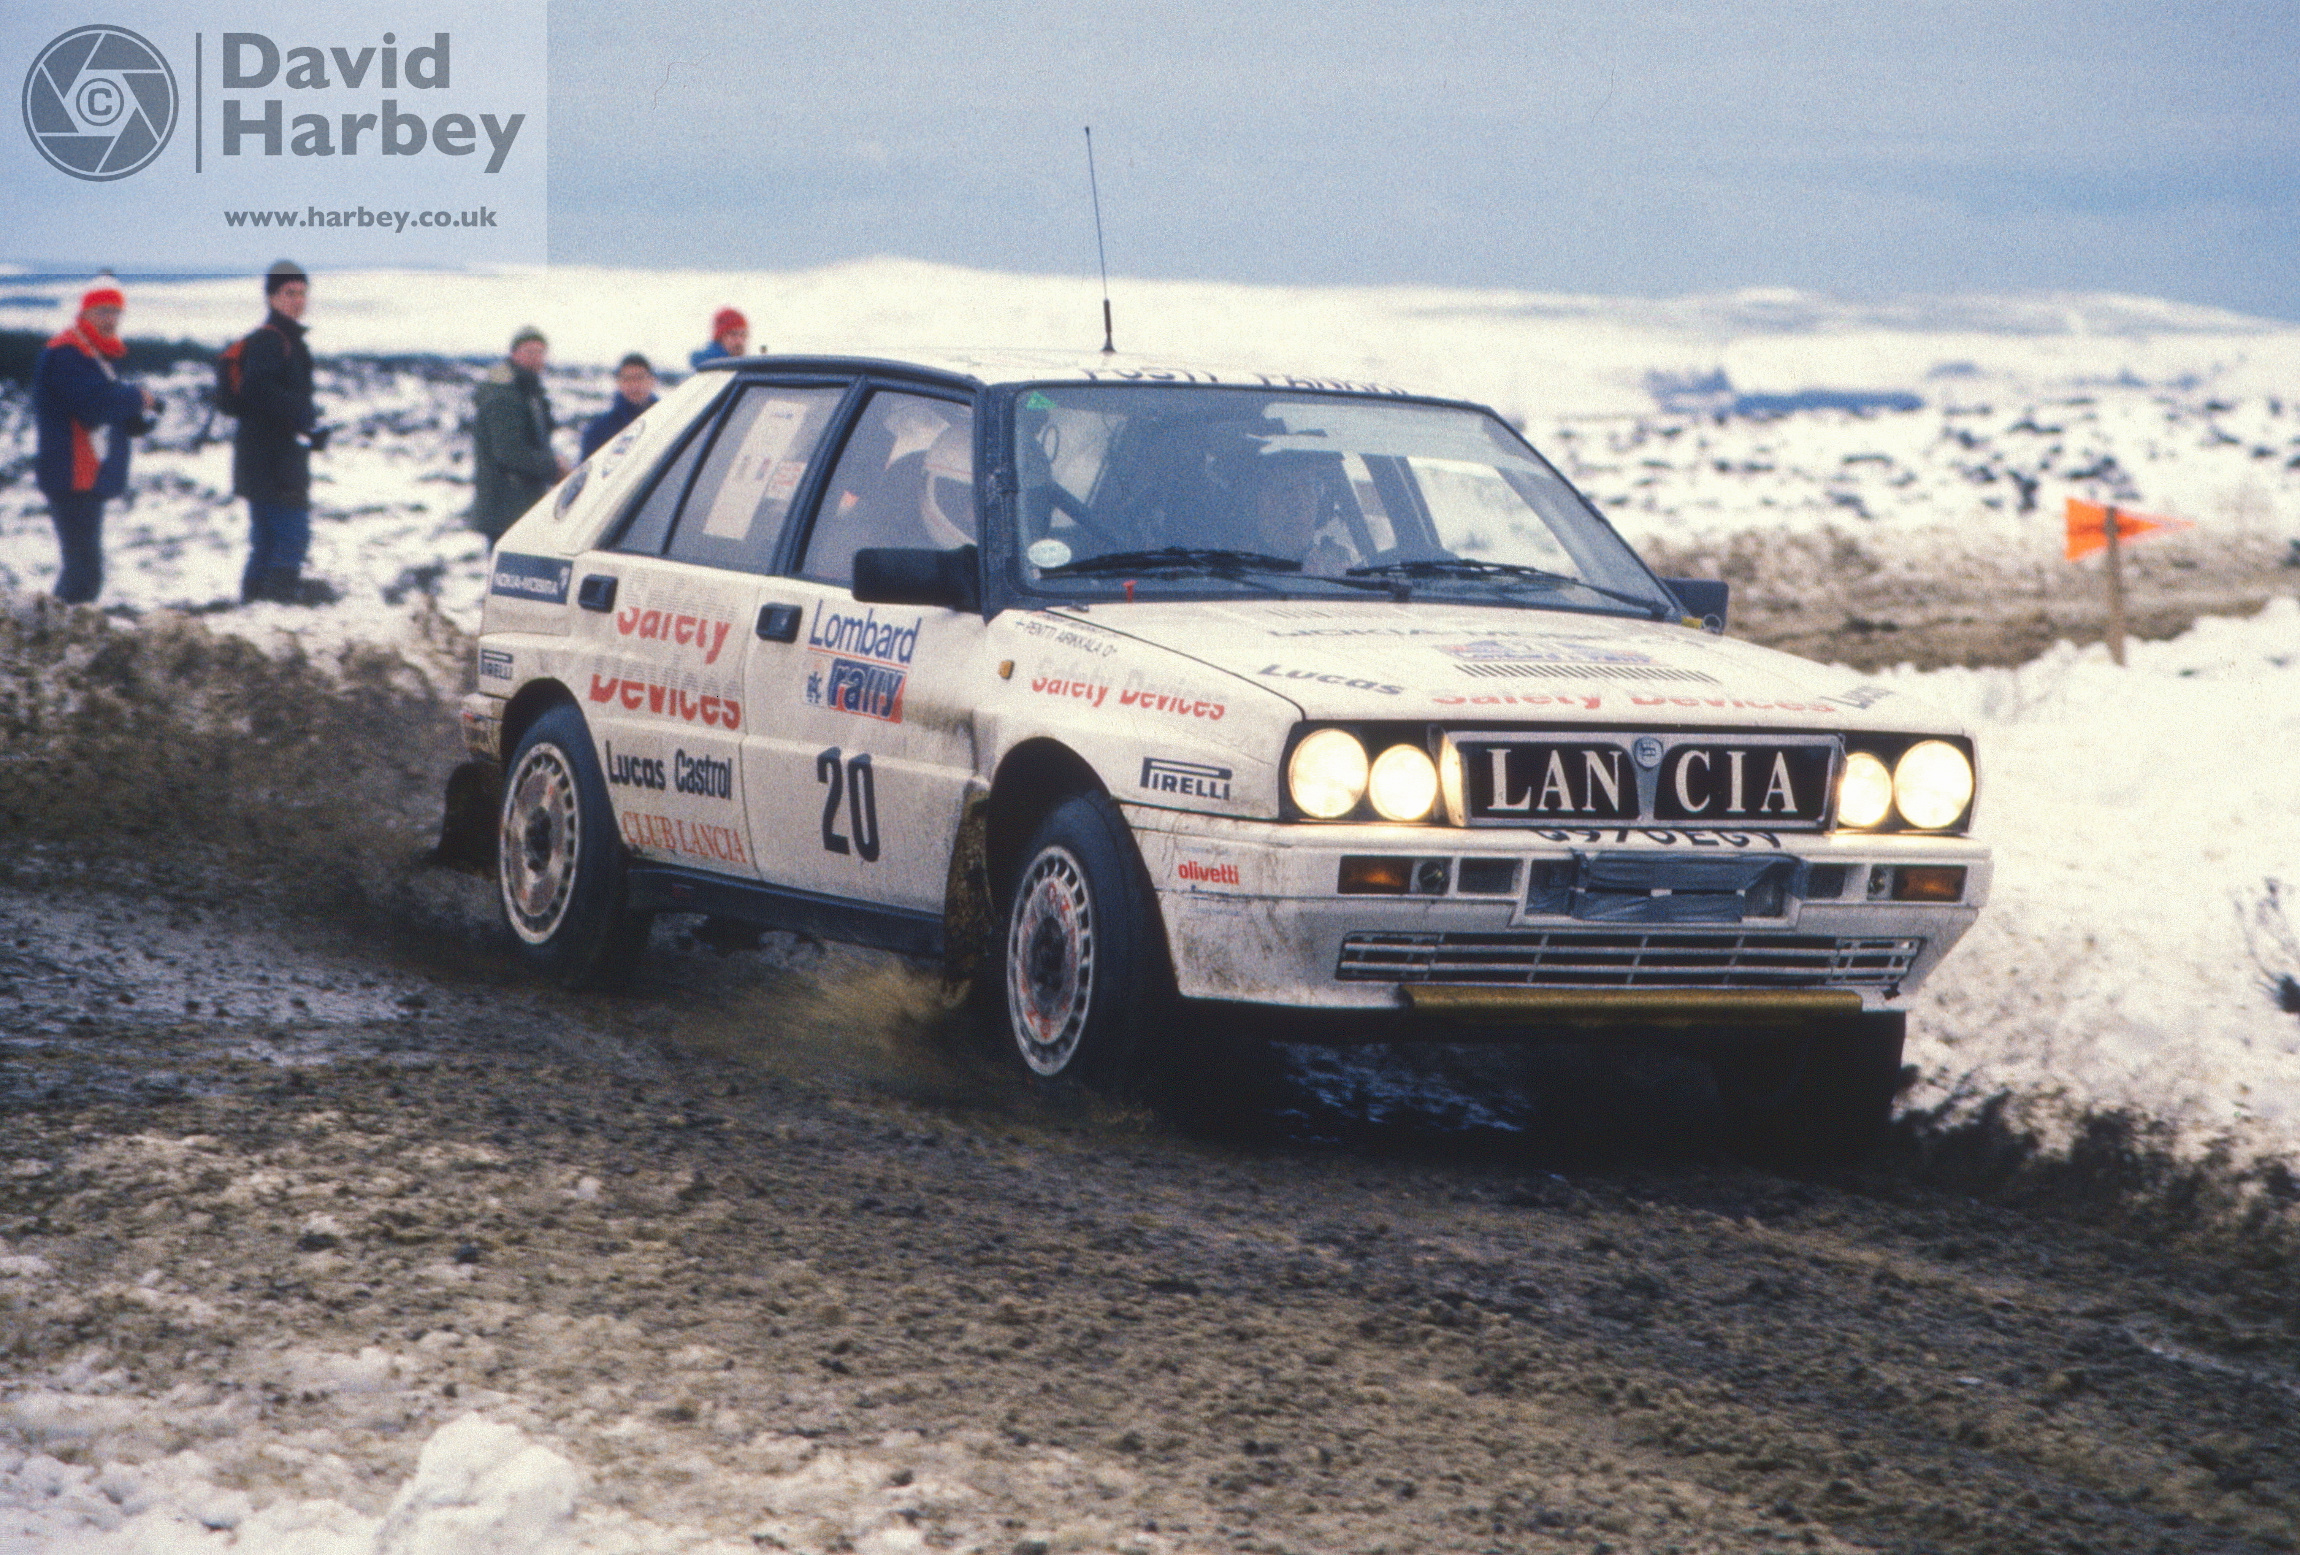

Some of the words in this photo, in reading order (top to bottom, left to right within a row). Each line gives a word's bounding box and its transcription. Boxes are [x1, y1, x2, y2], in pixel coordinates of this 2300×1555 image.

[617, 570, 737, 664] Safety
[808, 599, 922, 664] Lombard
[590, 655, 742, 730] Devices
[1119, 670, 1228, 721] Devices
[1258, 664, 1404, 695] Lucas
[605, 739, 666, 790] Lucas
[674, 748, 732, 800] Castrol
[1140, 757, 1233, 801] PIRELLI
[817, 746, 880, 863] 20
[621, 811, 676, 850] CLUB
[676, 819, 747, 863] LANCIA
[1178, 859, 1240, 885] olivetti
